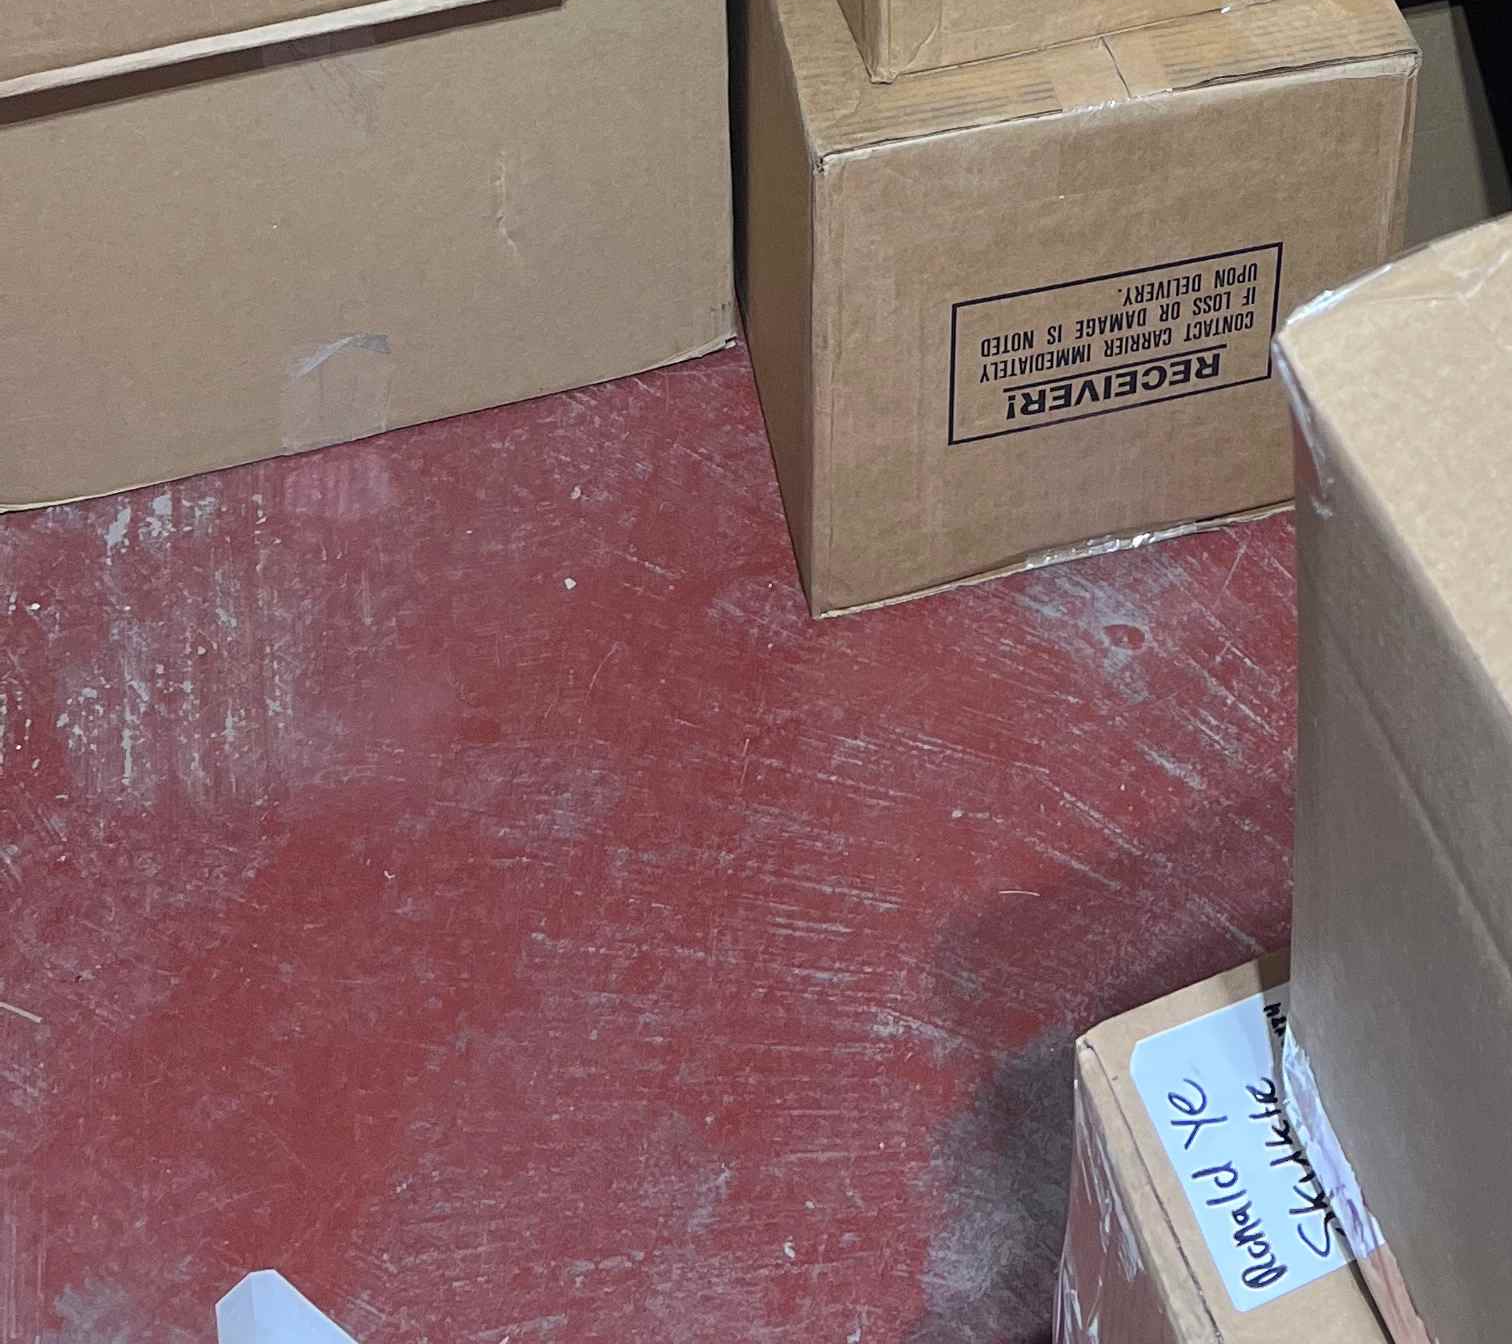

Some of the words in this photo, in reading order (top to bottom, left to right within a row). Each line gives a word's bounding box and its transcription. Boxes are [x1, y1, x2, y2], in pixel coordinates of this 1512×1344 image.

[1214, 263, 1257, 288] UPON
[1117, 277, 1201, 307] DELIVERY.
[1193, 291, 1231, 317] LOSS
[1242, 286, 1256, 307] IF
[1075, 307, 1146, 340] DAMAGE
[1159, 301, 1181, 322] OR
[1183, 311, 1254, 342] CONTACT
[981, 330, 1034, 358] NOTED
[1047, 324, 1062, 345] IS
[1104, 327, 1172, 358] CARRIER
[980, 343, 1091, 384] IMMEDIATELY
[1006, 353, 1221, 420] RECEIVER!
[1191, 1160, 1288, 1289] Ronald
